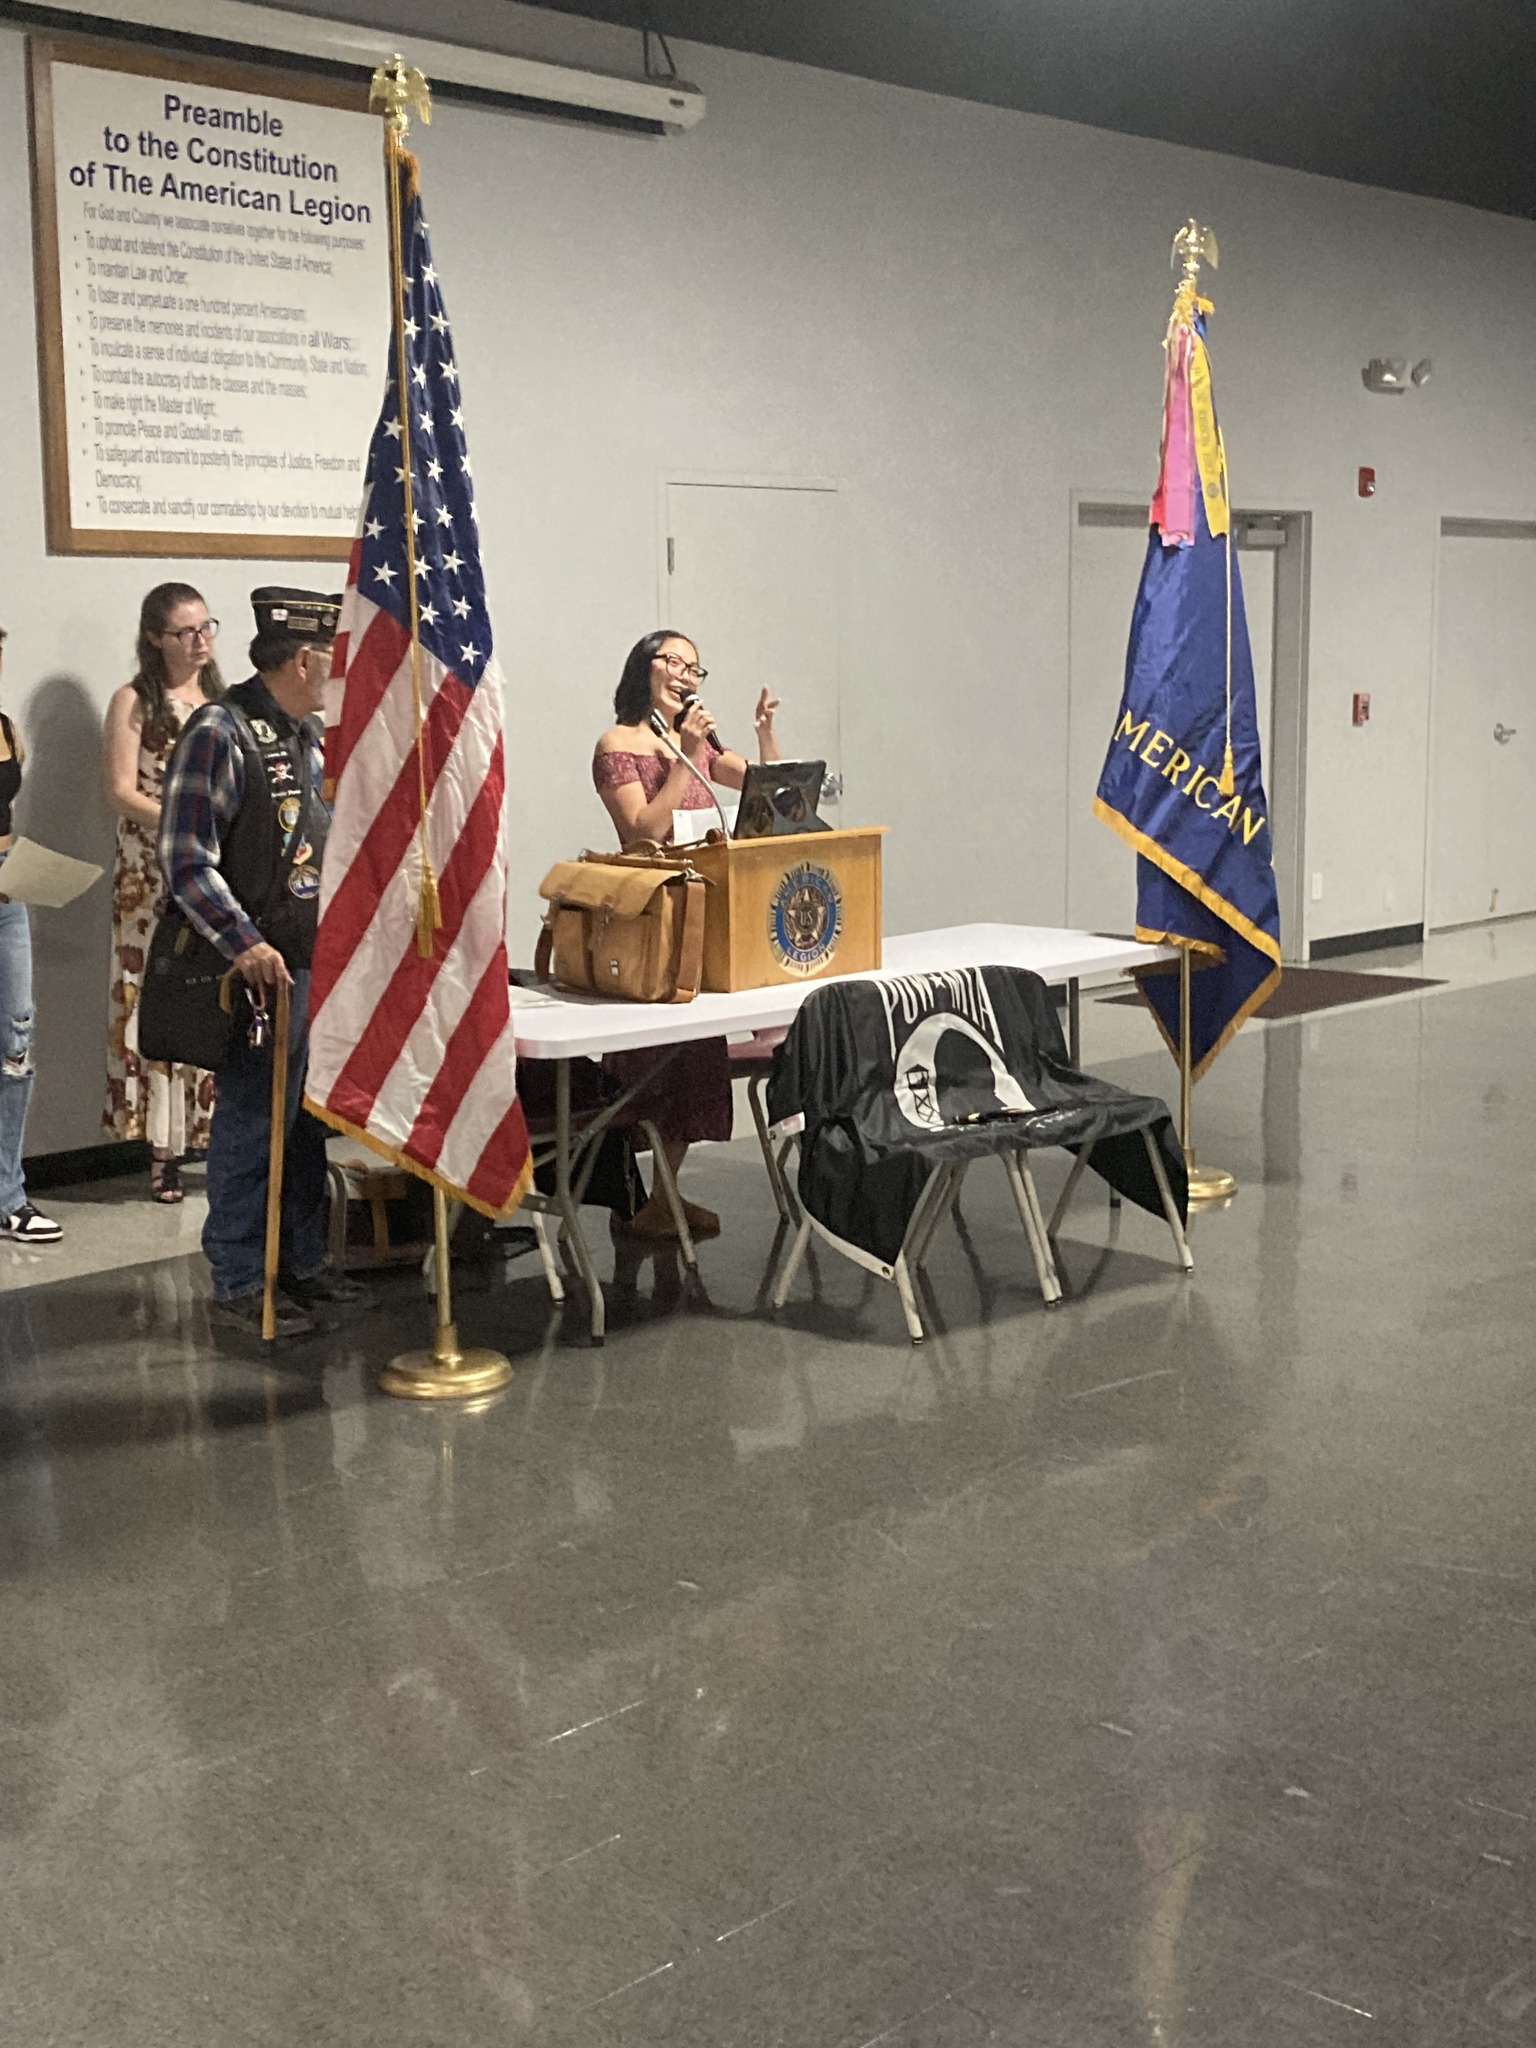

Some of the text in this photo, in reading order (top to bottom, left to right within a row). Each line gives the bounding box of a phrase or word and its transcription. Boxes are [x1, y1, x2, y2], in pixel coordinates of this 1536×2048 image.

[164, 94, 284, 137] Preamble
[103, 126, 339, 182] to the Constitution
[69, 162, 372, 226] of The American Legion
[84, 203, 96, 219] For
[98, 205, 114, 221] God
[116, 208, 130, 223] and
[162, 215, 173, 228] we
[174, 216, 210, 233] associate
[210, 220, 245, 237] ourselves
[246, 222, 275, 243] together
[274, 226, 286, 241] for
[288, 227, 298, 243] the
[300, 229, 330, 251] following
[84, 231, 94, 249] To
[96, 233, 122, 255] uphold
[123, 236, 138, 254] and
[140, 237, 164, 257] defend
[166, 240, 178, 258] the
[180, 242, 222, 263] Constitution
[224, 247, 232, 264] of
[232, 248, 244, 265] the
[246, 249, 269, 268] United
[270, 252, 292, 270] States
[294, 255, 302, 272] of
[86, 257, 96, 275] To
[97, 260, 129, 279] maintain
[130, 263, 147, 281] Law
[148, 266, 162, 283] and
[86, 284, 96, 302] To
[97, 285, 119, 304] foster
[120, 288, 134, 305] and
[136, 291, 176, 312] perpetuate
[177, 297, 182, 310] a
[184, 298, 198, 312] one
[200, 295, 230, 315] hundred
[230, 301, 258, 320] percent
[88, 312, 98, 330] To
[99, 317, 132, 335] preserve
[132, 316, 145, 333] the
[147, 319, 184, 336] memories
[184, 320, 200, 337] and
[200, 321, 232, 340] incidents
[234, 324, 242, 341] of
[242, 328, 254, 342] our
[255, 327, 298, 345] associations
[307, 330, 320, 347] all
[90, 338, 99, 356] To
[134, 346, 140, 359] a
[141, 346, 164, 361] sense
[165, 344, 174, 361] of
[174, 344, 208, 364] individual
[210, 347, 244, 370] obligation
[244, 350, 253, 367] to
[254, 350, 266, 368] the
[308, 354, 328, 372] State
[330, 357, 342, 373] and
[90, 364, 100, 382] To
[101, 366, 130, 384] combat
[130, 367, 144, 385] the
[145, 369, 180, 392] autocracy
[182, 371, 190, 388] of
[190, 372, 208, 389] both
[208, 373, 220, 390] the
[221, 374, 249, 393] classes
[250, 377, 264, 394] and
[264, 377, 276, 395] the
[92, 391, 102, 408] To
[103, 392, 126, 410] make
[126, 393, 142, 415] right
[142, 394, 156, 412] the
[157, 395, 184, 413] Master
[184, 397, 192, 414] of
[93, 417, 103, 435] To
[104, 419, 136, 440] promote
[136, 420, 162, 438] Peace
[162, 422, 178, 439] and
[210, 428, 220, 441] on
[93, 444, 104, 461] To
[104, 445, 142, 467] safeguard
[144, 446, 159, 463] and
[159, 447, 190, 465] transmit
[190, 448, 198, 465] to
[200, 449, 230, 471] posterity
[230, 450, 243, 467] the
[244, 450, 278, 473] principles
[278, 452, 287, 468] of
[314, 453, 345, 470] Freedom
[346, 455, 360, 471] and
[96, 496, 107, 513] To
[108, 497, 150, 514] consecrate
[152, 498, 166, 514] and
[167, 499, 194, 520] sanctify
[196, 503, 208, 515] our
[210, 500, 256, 522] comradeship
[256, 501, 266, 522] by
[267, 505, 280, 517] our
[280, 502, 310, 518] devotion
[310, 503, 318, 518] to
[318, 504, 342, 519] mutual
[1113, 709, 1266, 846] MERICAN
[799, 910, 814, 926] US
[786, 943, 827, 963] LEGION
